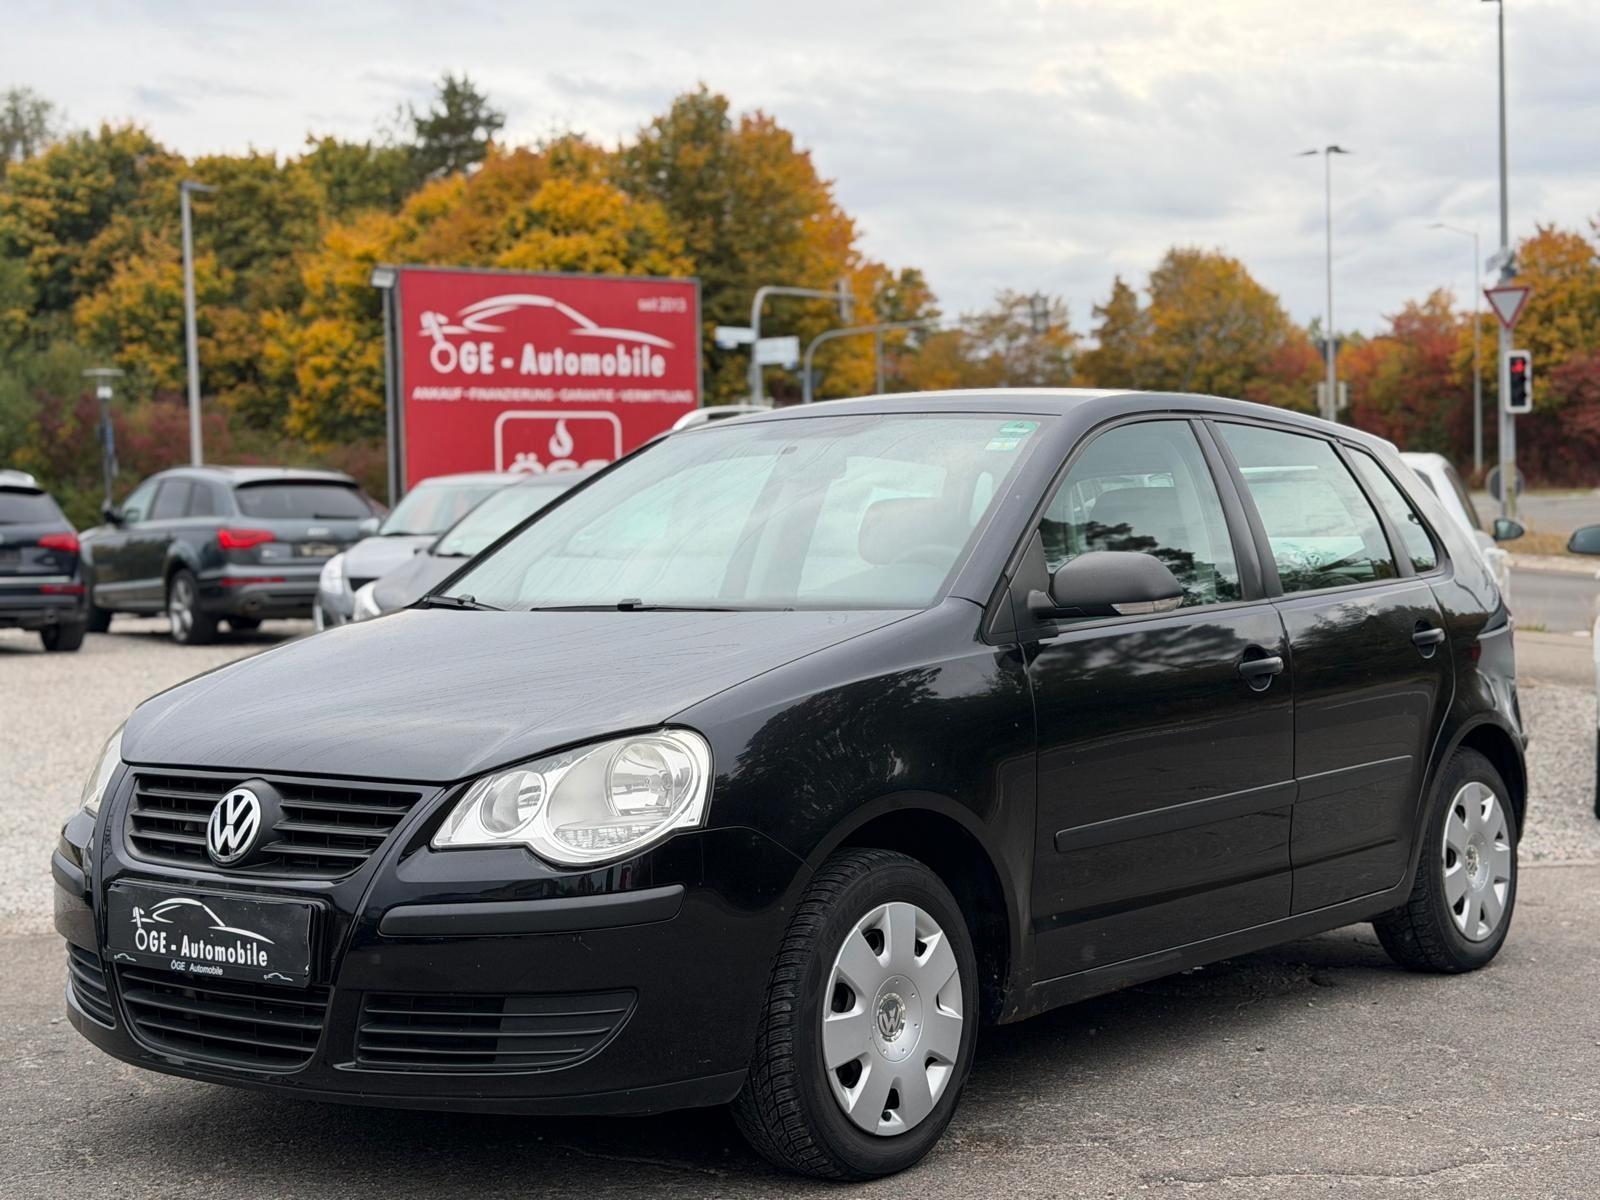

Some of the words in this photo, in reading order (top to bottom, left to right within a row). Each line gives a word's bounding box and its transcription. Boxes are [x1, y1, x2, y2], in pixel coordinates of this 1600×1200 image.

[520, 342, 666, 378] Automobile
[181, 934, 267, 967] Automobile
[189, 962, 223, 976] Automobile
